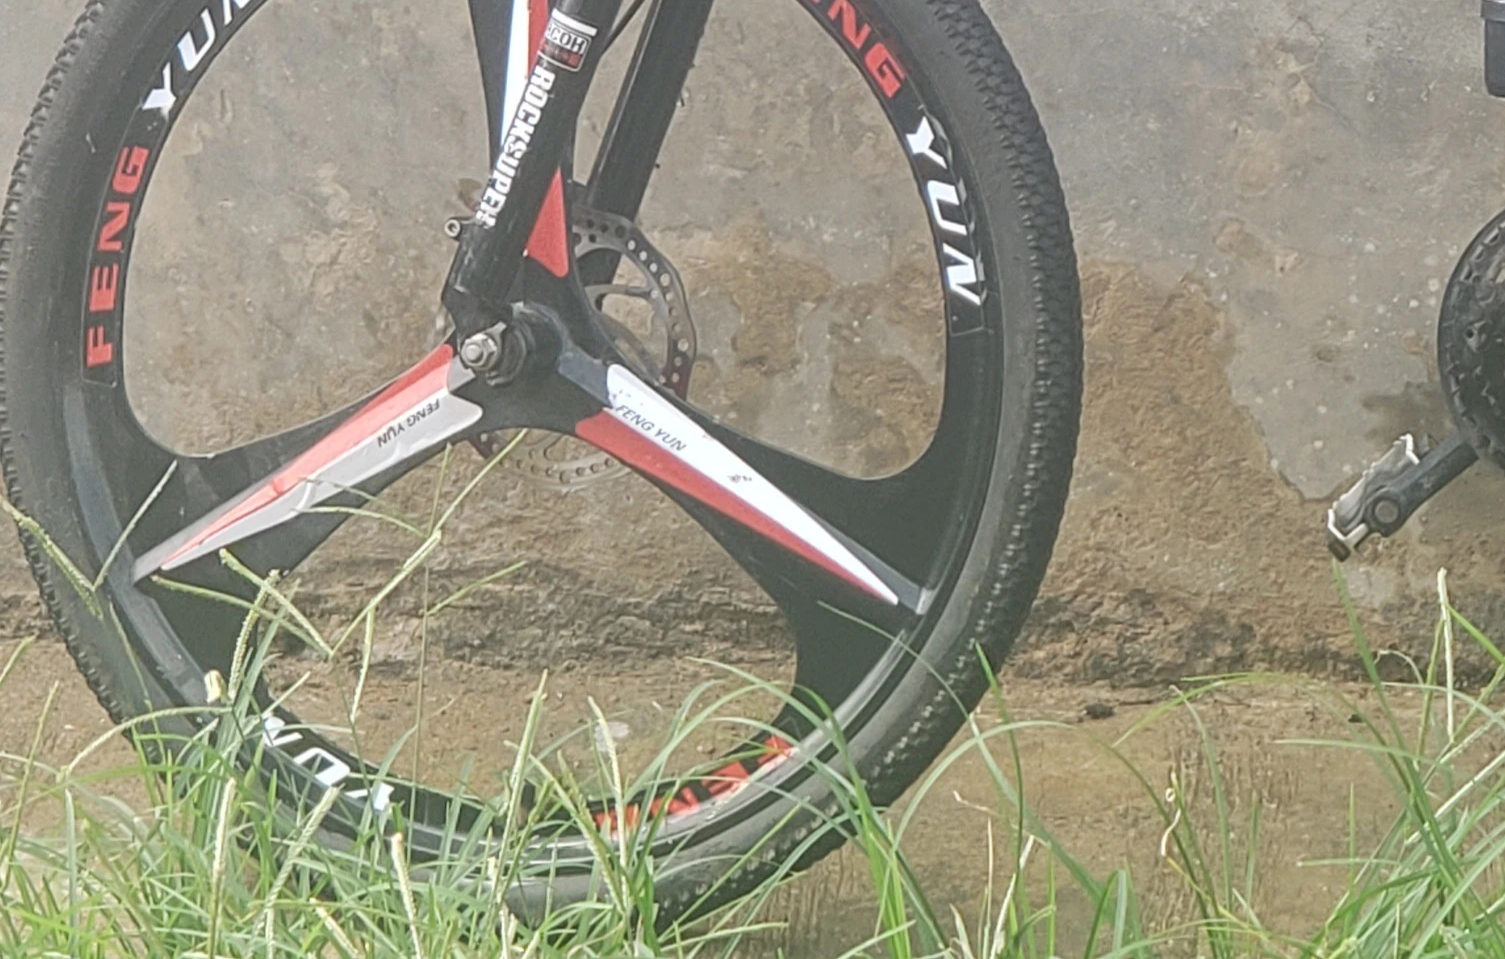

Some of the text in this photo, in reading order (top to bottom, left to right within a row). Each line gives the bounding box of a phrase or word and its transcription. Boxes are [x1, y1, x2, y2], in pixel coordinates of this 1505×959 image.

[86, 146, 150, 368] FENG
[905, 116, 984, 307] YUN
[376, 397, 441, 448] FENG YUN
[615, 404, 687, 451] FENG YUN
